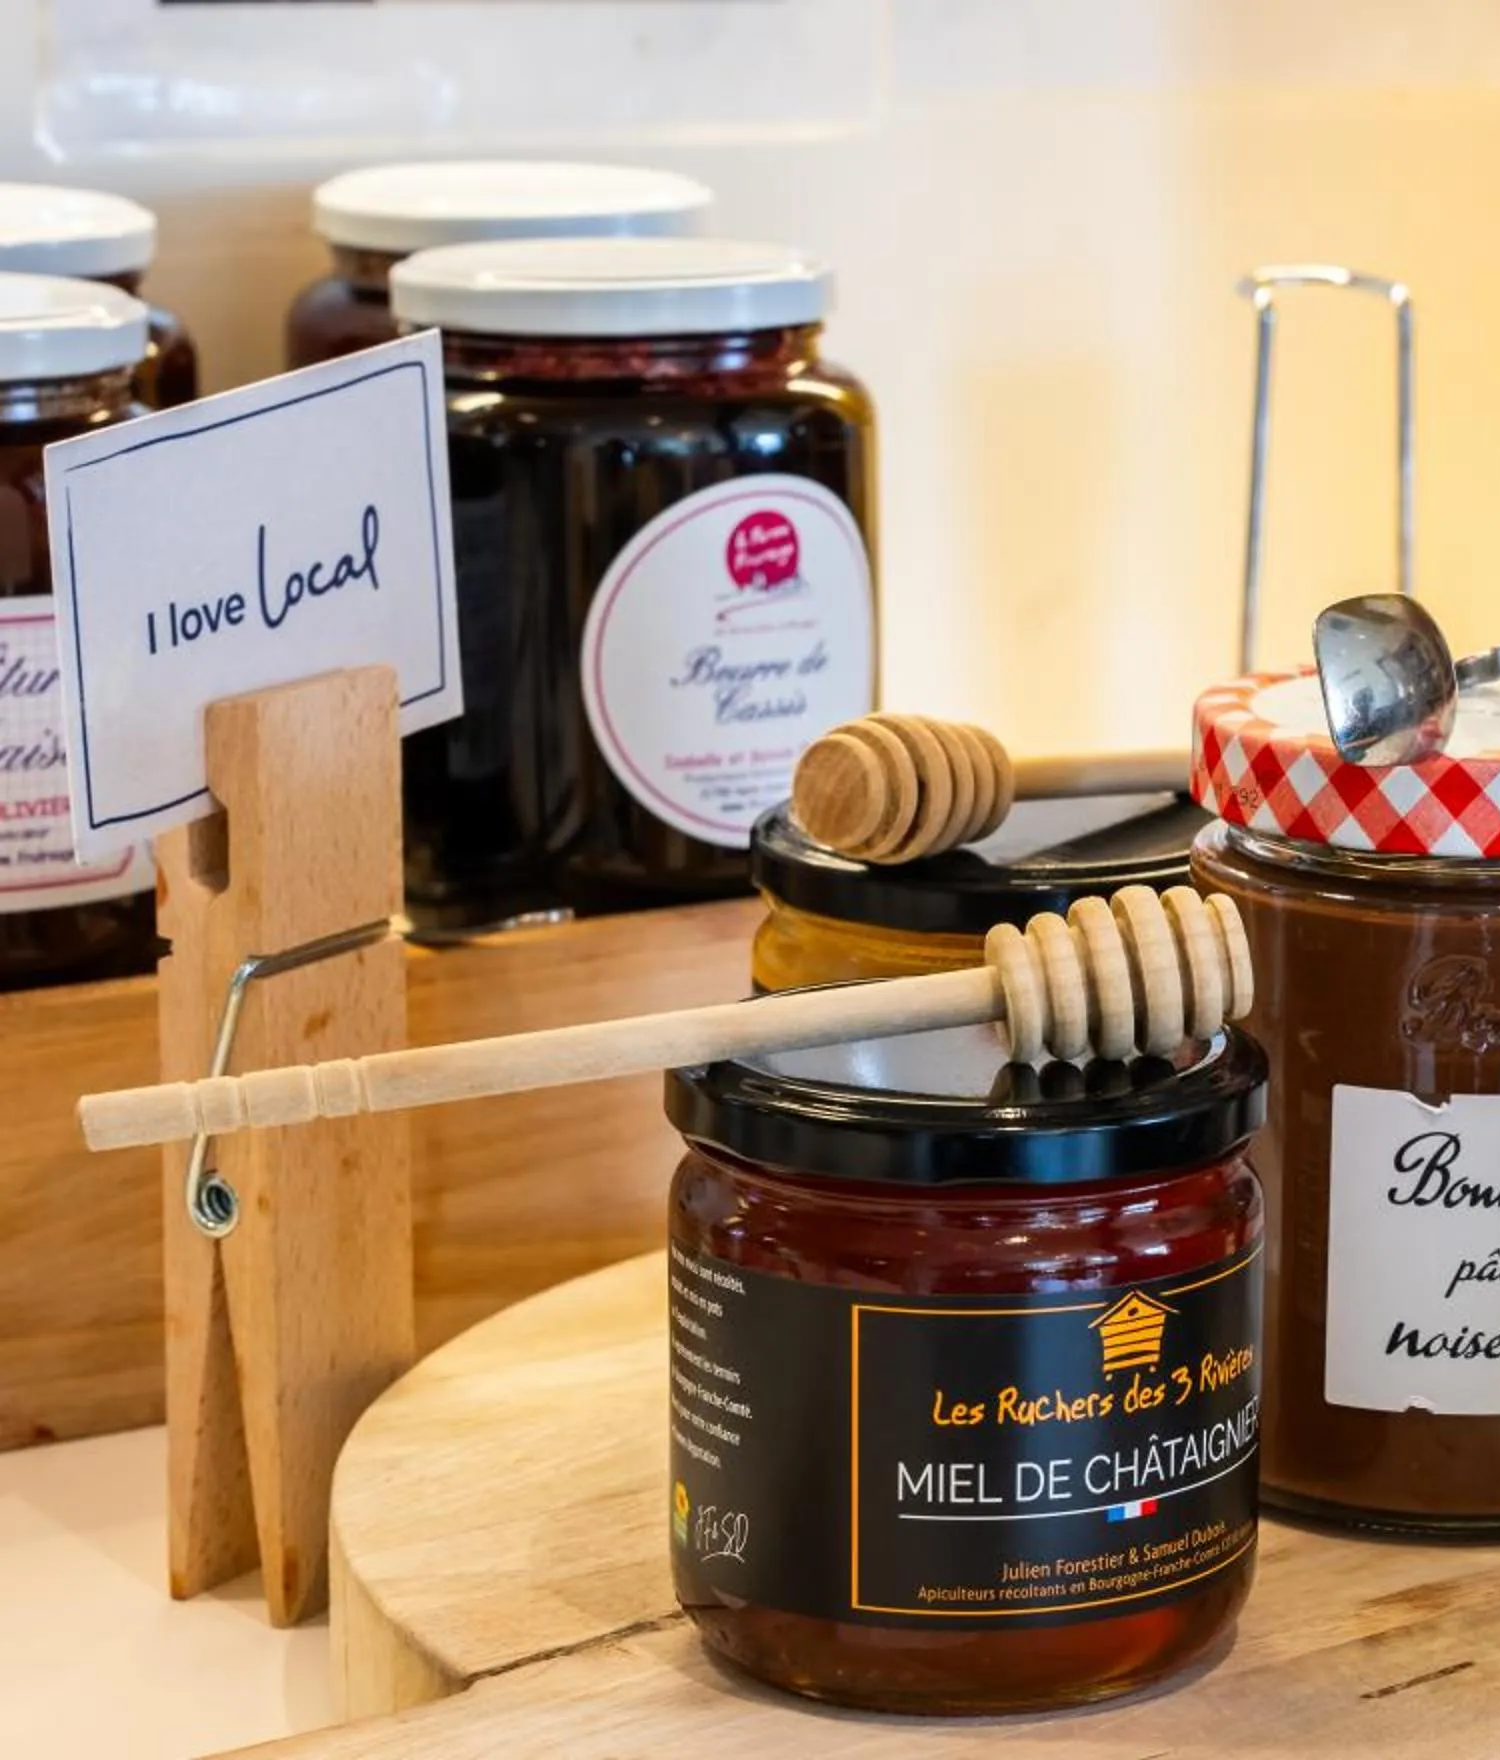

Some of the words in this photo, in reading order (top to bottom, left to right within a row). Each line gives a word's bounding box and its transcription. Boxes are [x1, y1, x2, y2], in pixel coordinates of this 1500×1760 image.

[147, 612, 157, 655] I
[171, 592, 246, 648] love
[796, 640, 828, 678] de
[933, 1389, 984, 1426] Les
[997, 1385, 1114, 1426] Ruchers
[1123, 1373, 1166, 1414] des
[1171, 1365, 1193, 1406] 3
[897, 1461, 1003, 1503] MIEL
[1015, 1458, 1073, 1502] DE
[1001, 1562, 1051, 1583] Julien
[1056, 1551, 1126, 1578] Forestier
[1129, 1549, 1140, 1565] &
[1143, 1536, 1190, 1563] Samuel
[917, 1585, 996, 1602] Apiculteurs
[1000, 1583, 1067, 1600] récoltants
[1070, 1582, 1086, 1595] en
